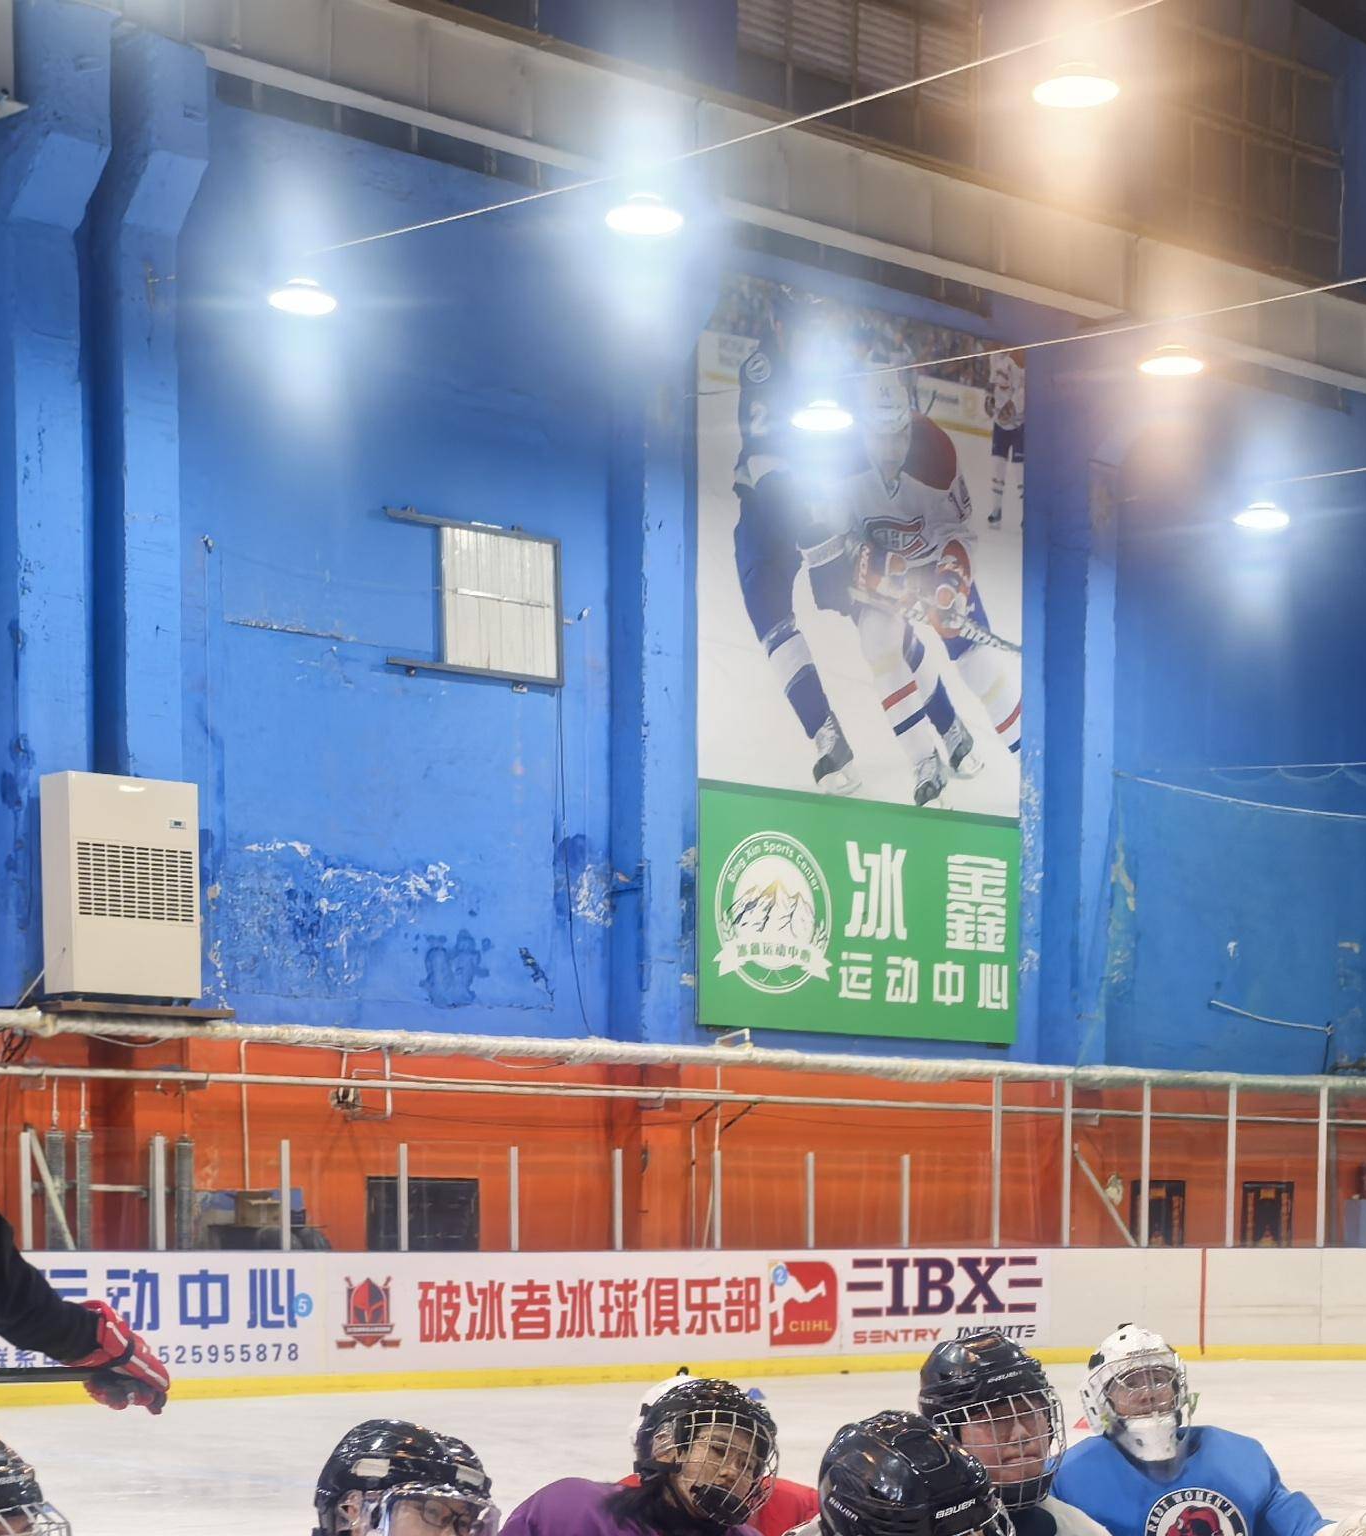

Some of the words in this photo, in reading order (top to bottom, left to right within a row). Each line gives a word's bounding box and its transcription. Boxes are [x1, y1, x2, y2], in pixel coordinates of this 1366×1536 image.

[763, 840, 795, 857] Sports
[795, 852, 821, 892] Center
[843, 840, 1008, 953] 冰鑫
[838, 951, 1010, 1011] 运动中心
[417, 1276, 761, 1344] 破冰者冰球俱乐部
[789, 1319, 832, 1333] CIIHL
[852, 1327, 942, 1345] SENTRY
[828, 1496, 859, 1523] BAUER
[935, 1498, 977, 1520] BAUER
